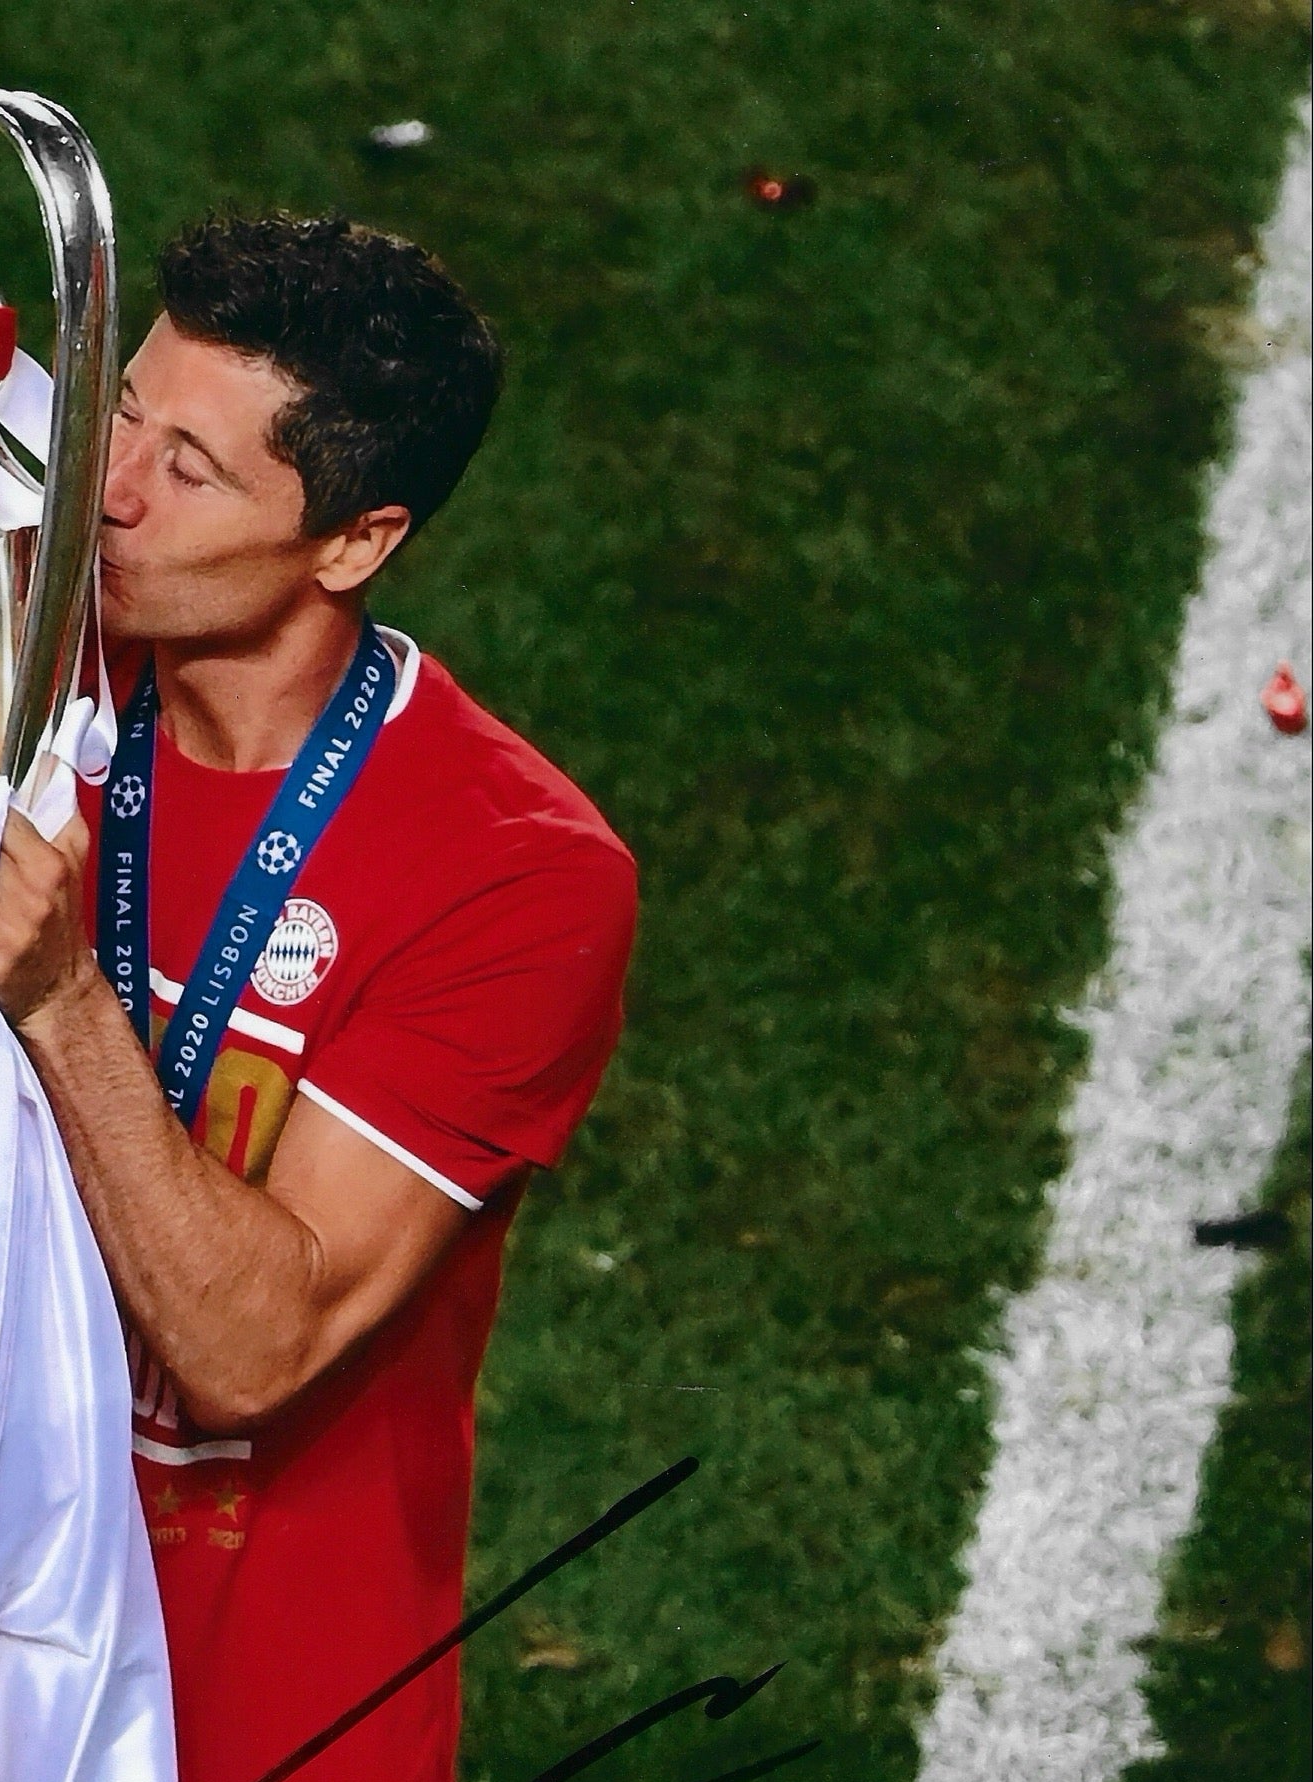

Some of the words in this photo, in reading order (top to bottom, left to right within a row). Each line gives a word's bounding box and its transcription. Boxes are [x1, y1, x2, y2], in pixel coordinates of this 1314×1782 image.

[298, 738, 352, 809] FINAL
[345, 665, 381, 730] 2020
[116, 852, 133, 932] FINAL
[116, 945, 134, 1012] 2020
[174, 1013, 209, 1078] 2020
[201, 904, 259, 1006] LISBON
